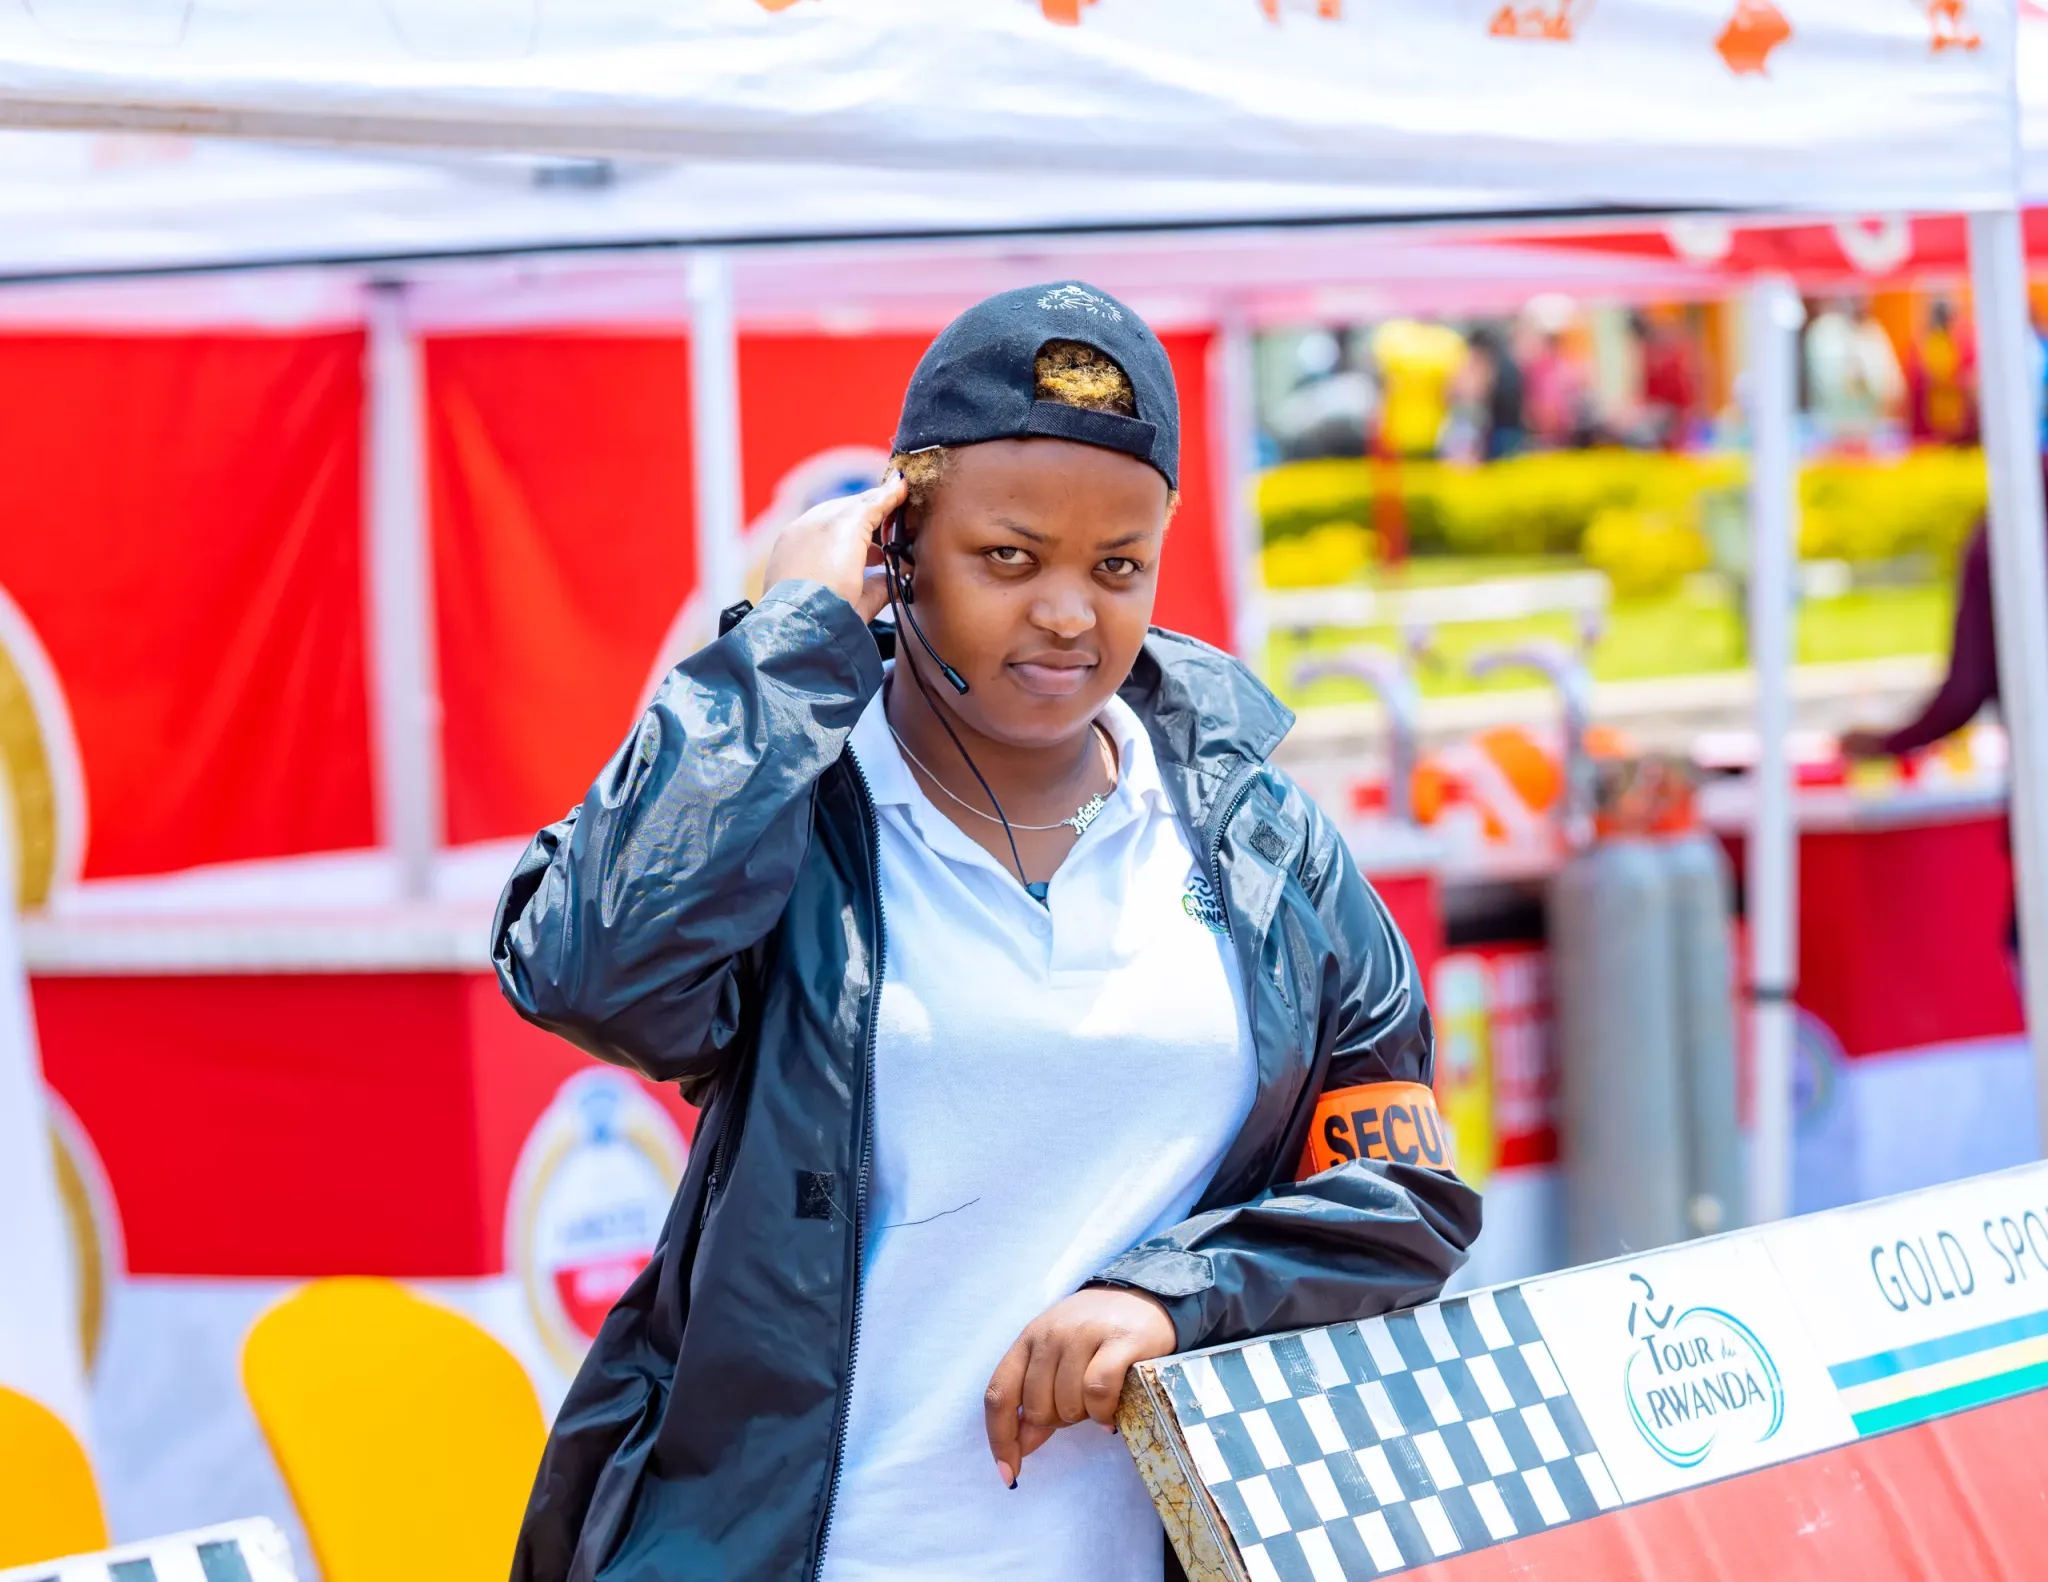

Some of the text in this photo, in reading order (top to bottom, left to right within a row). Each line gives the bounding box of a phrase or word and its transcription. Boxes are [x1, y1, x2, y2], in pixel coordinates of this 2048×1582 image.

[1323, 1104, 1447, 1167] SECU
[1871, 1206, 2048, 1312] GOLD SPO
[1646, 1367, 1766, 1430] RWANDA
